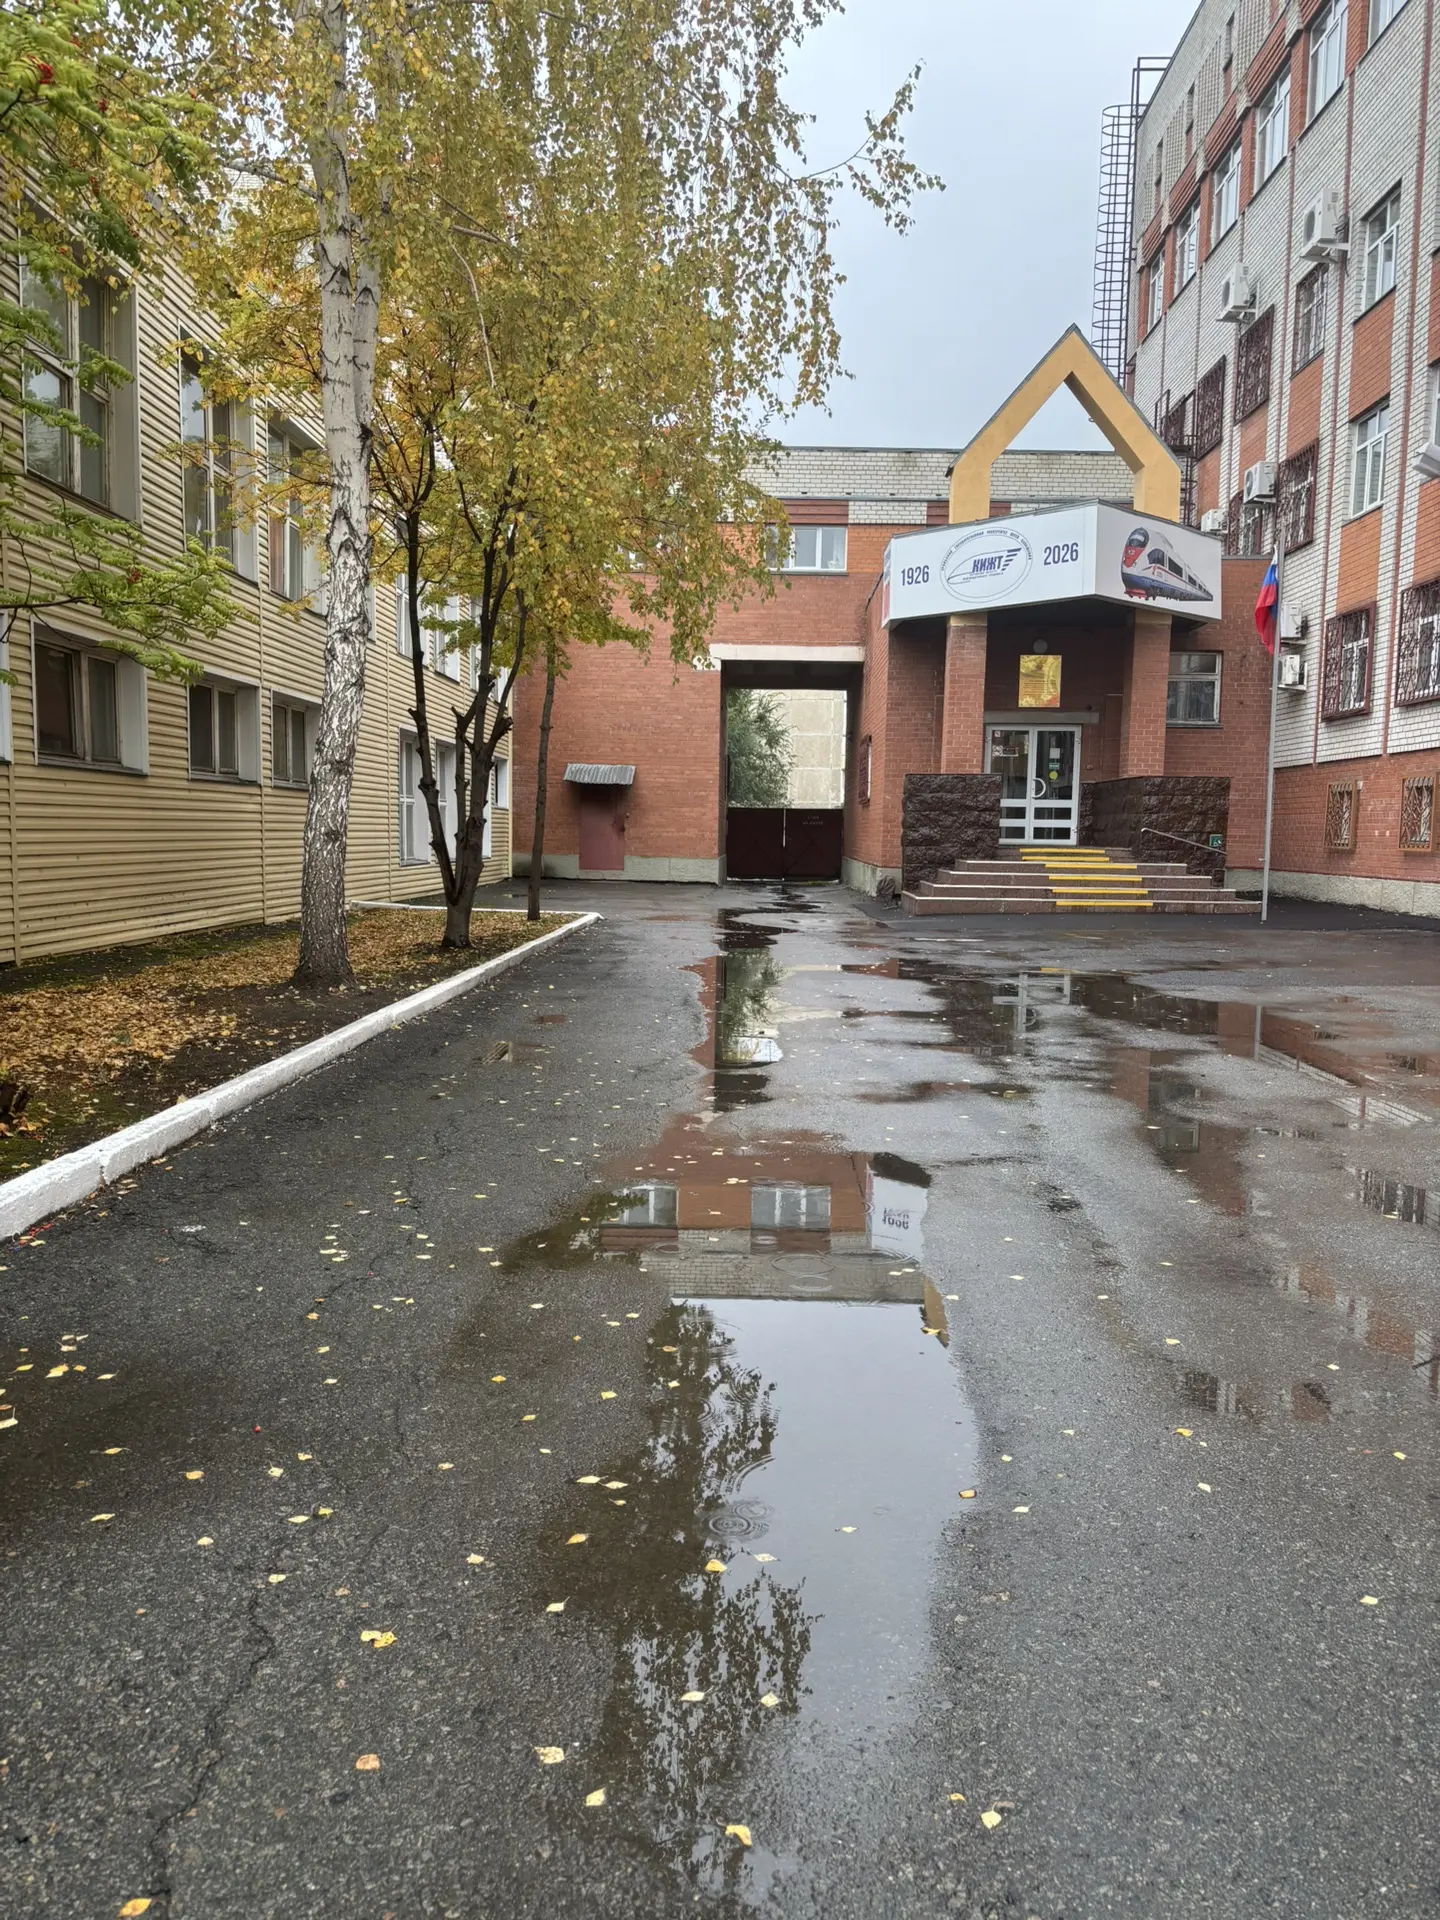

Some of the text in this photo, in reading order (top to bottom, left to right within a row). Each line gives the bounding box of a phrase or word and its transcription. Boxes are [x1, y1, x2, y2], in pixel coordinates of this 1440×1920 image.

[972, 555, 1004, 573] КИЖТ
[1043, 542, 1079, 566] 2026
[900, 565, 930, 586] 1926
